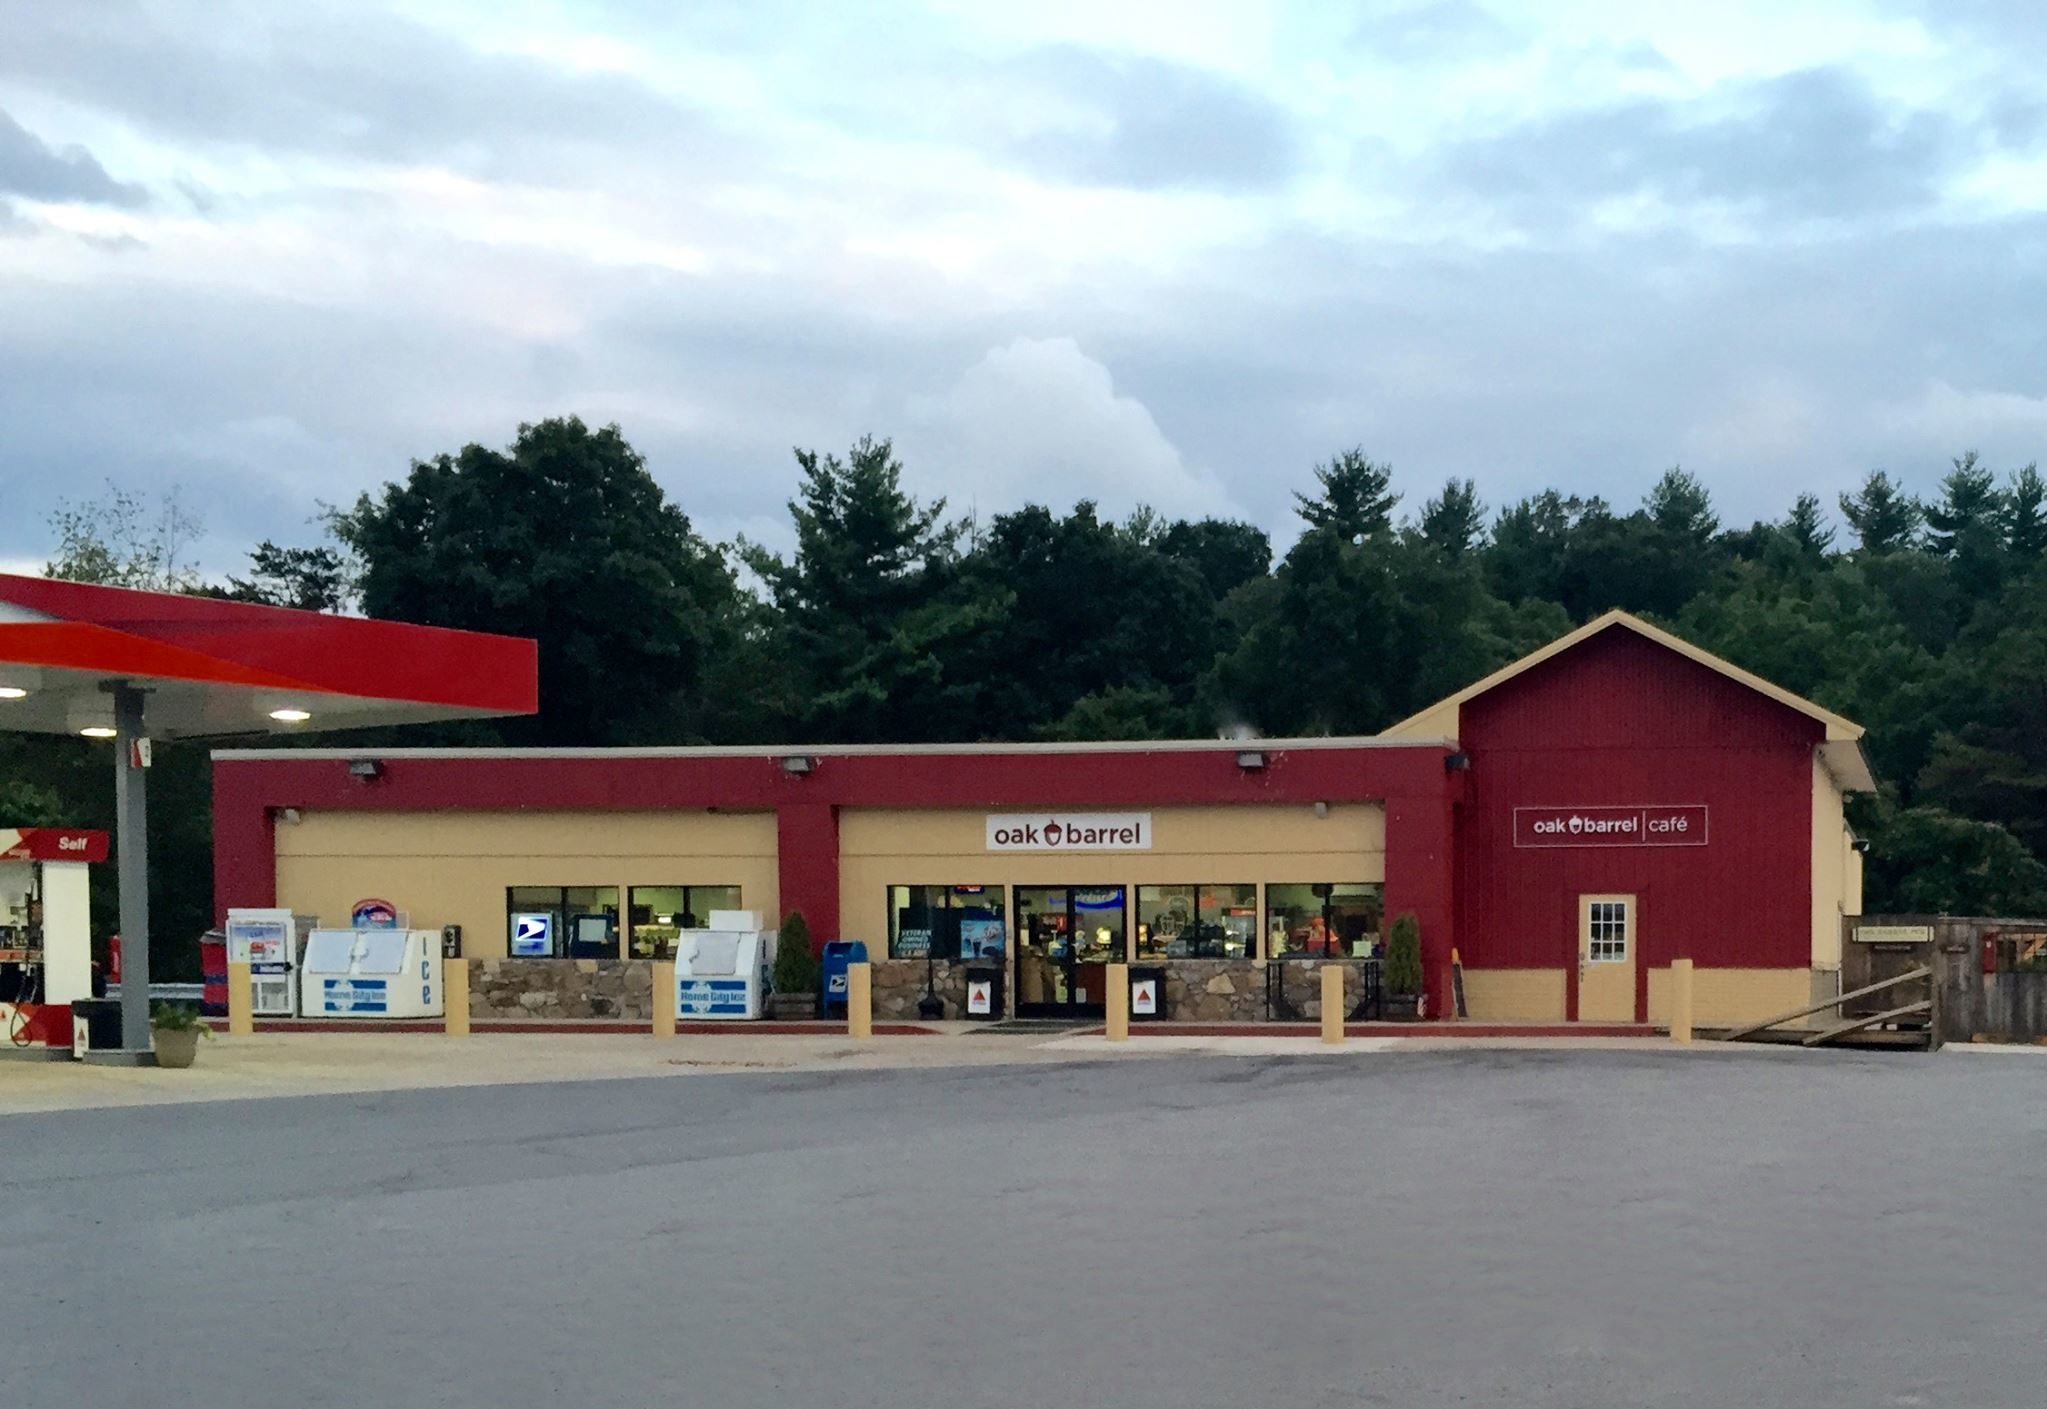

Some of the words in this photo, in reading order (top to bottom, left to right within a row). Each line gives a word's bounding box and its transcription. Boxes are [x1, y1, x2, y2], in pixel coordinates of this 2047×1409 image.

[1533, 818, 1566, 833] oak
[1584, 816, 1638, 833] barrel
[1648, 816, 1688, 832] café
[995, 824, 1039, 844] oak
[1066, 822, 1140, 844] barrel
[58, 836, 88, 850] Self
[324, 990, 351, 1000] Home
[681, 991, 709, 1001] Home
[710, 991, 730, 1003] City
